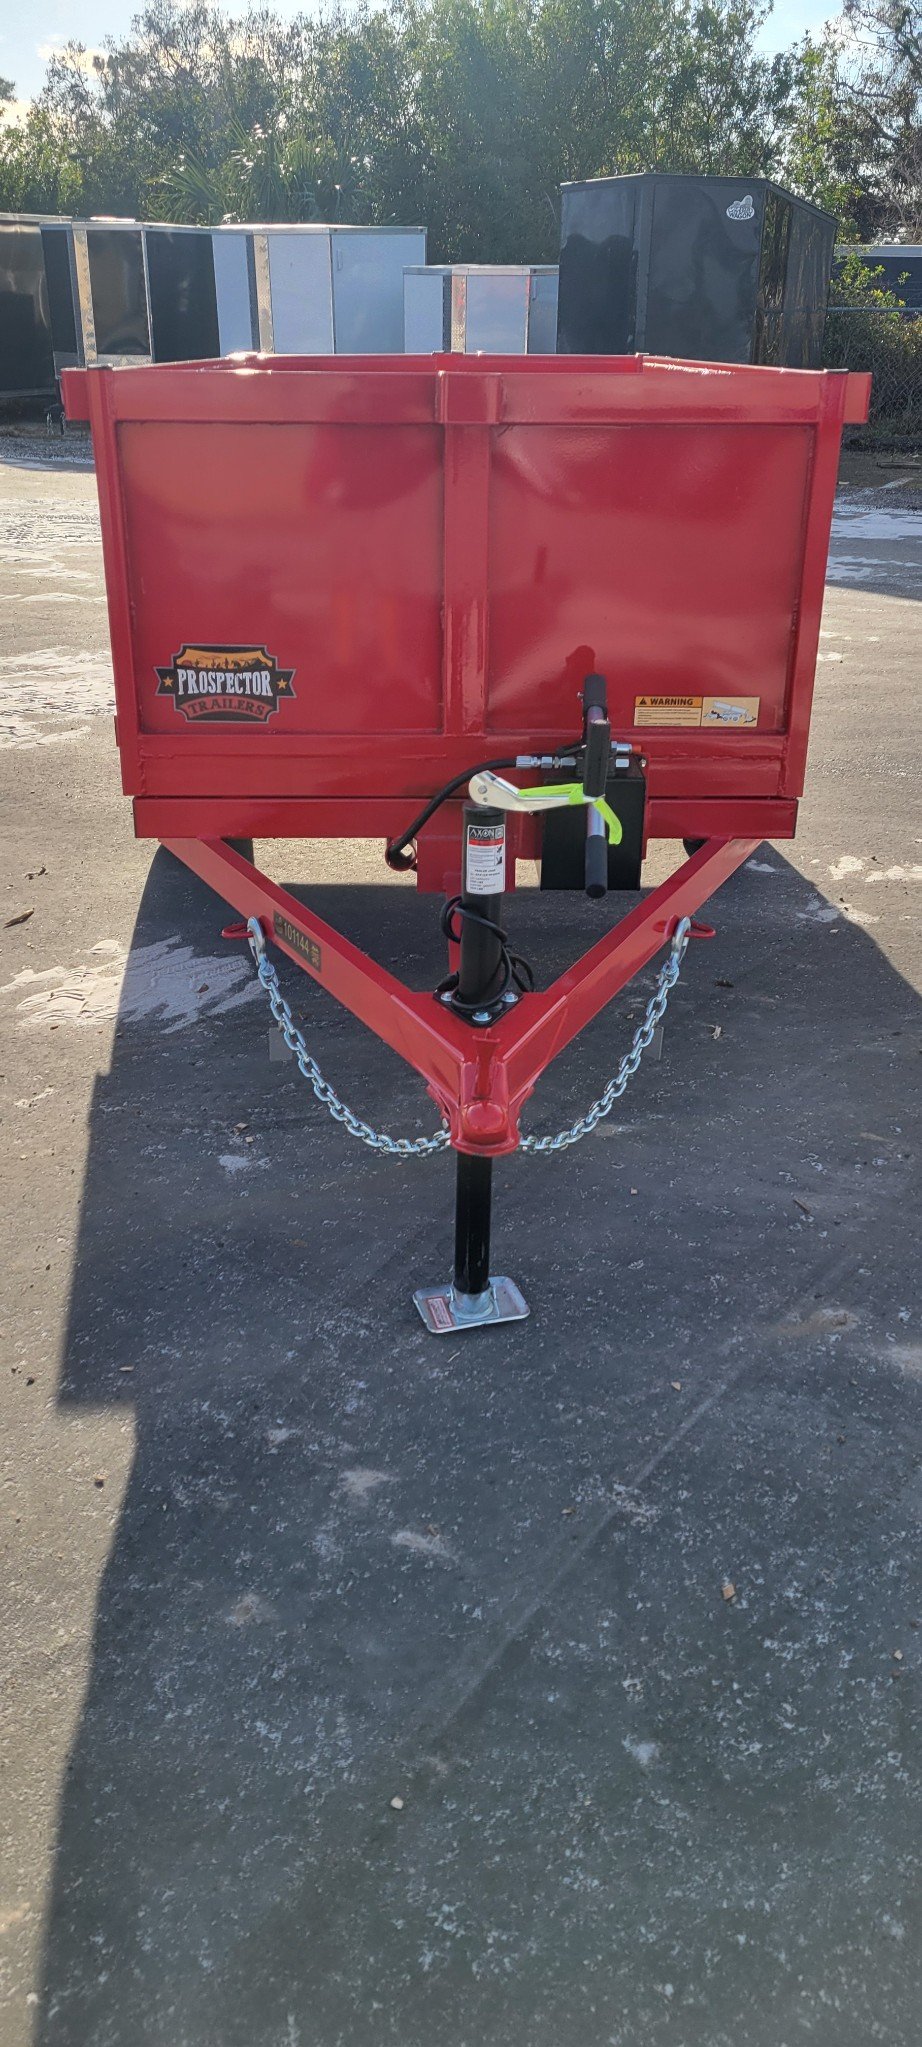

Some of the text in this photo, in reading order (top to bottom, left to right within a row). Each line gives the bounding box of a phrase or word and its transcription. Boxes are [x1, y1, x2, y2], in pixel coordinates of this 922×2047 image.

[177, 668, 273, 696] PROSPECTOR
[187, 699, 265, 716] TRAILERS
[650, 697, 694, 706] WARNING
[470, 828, 495, 839] AXON
